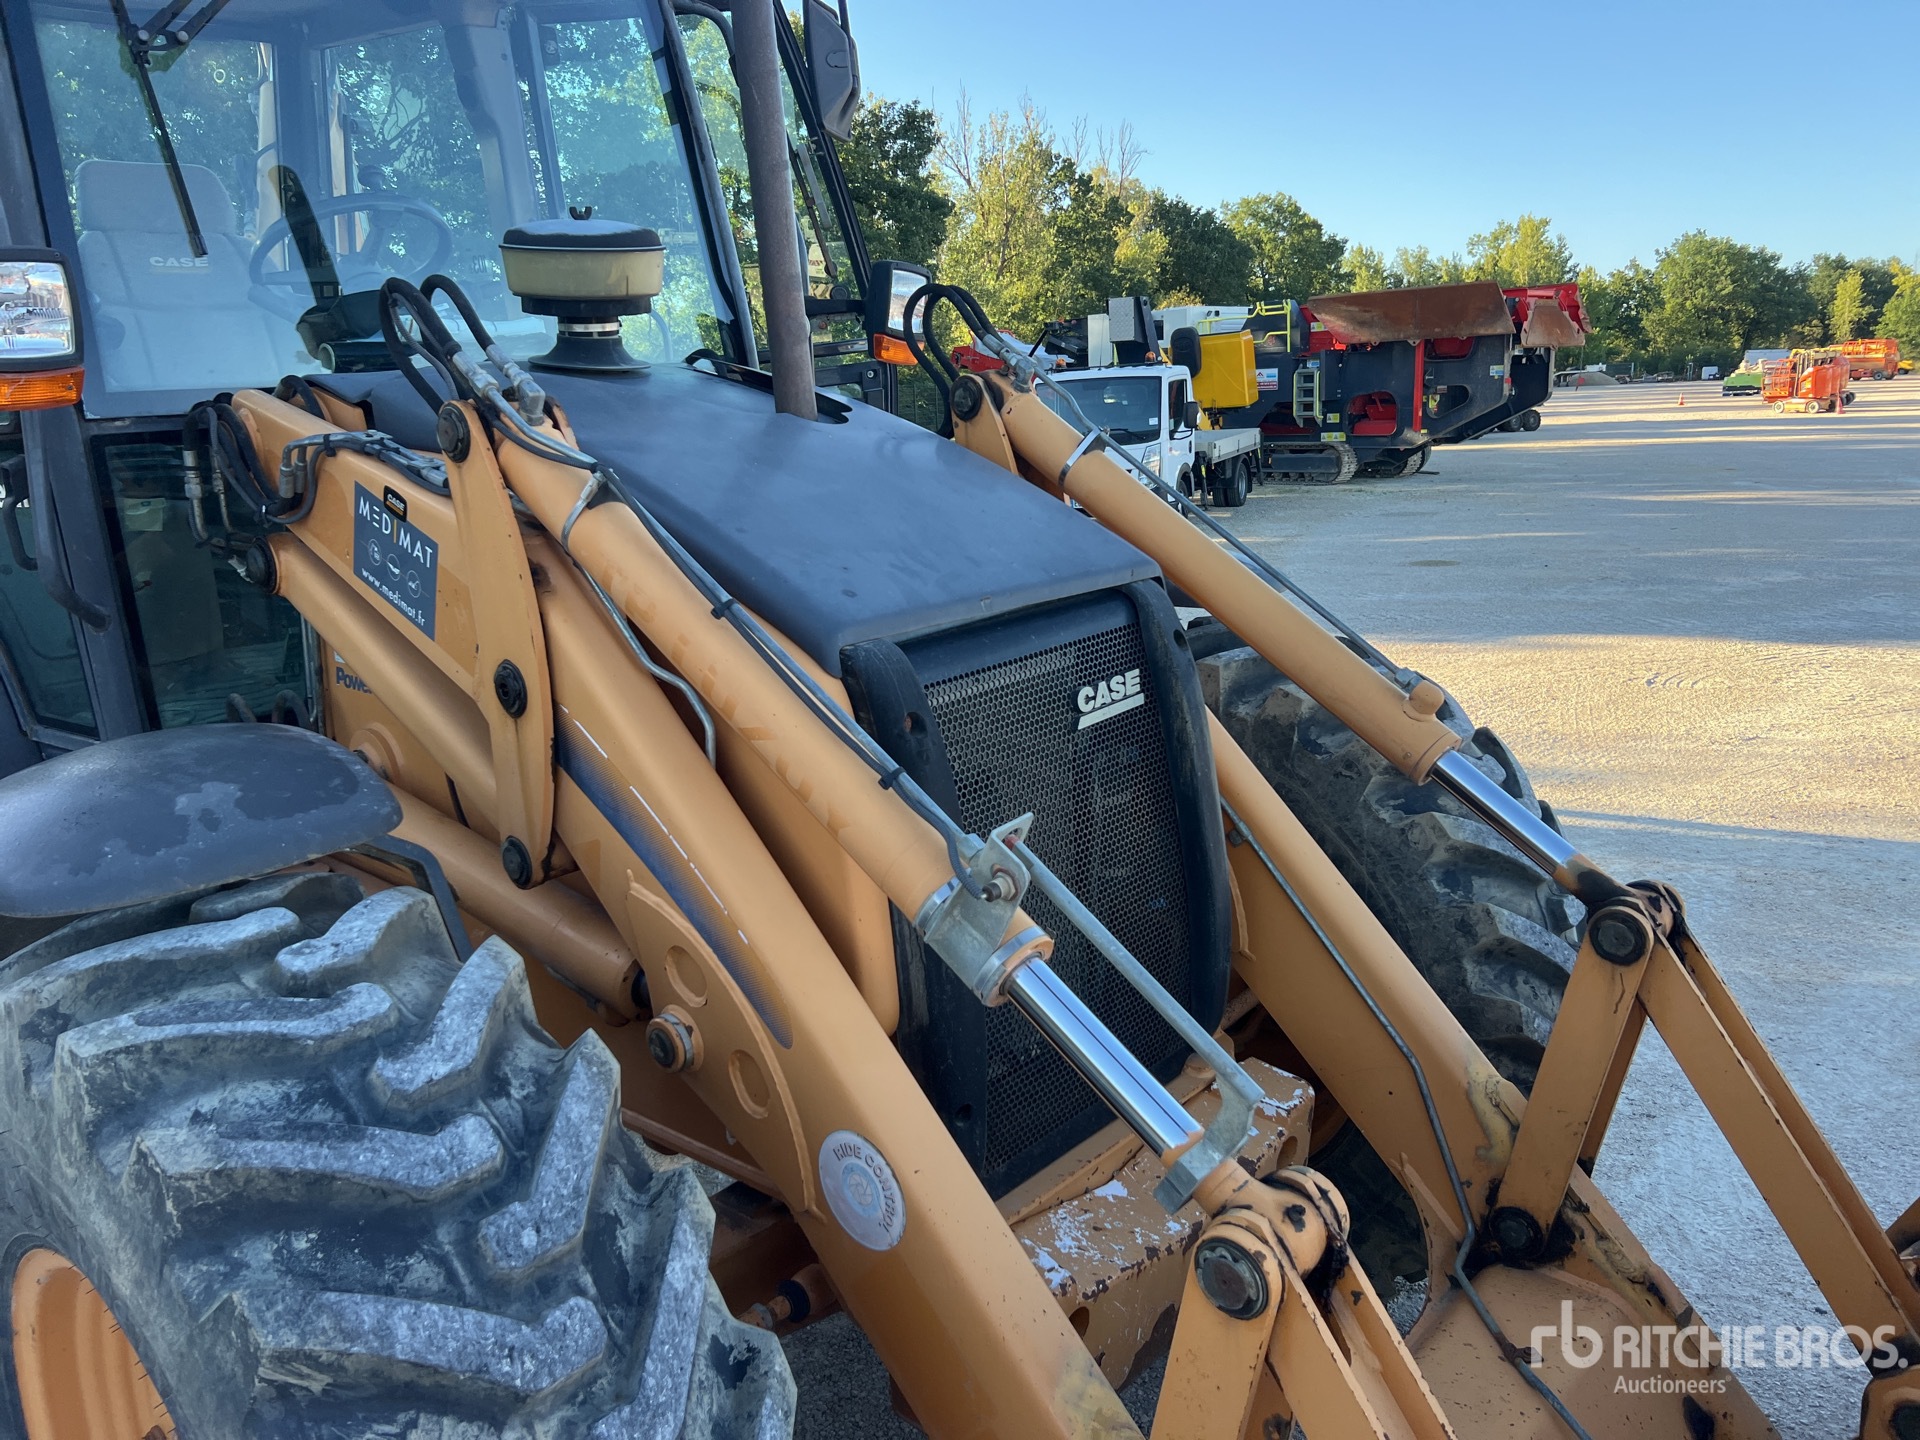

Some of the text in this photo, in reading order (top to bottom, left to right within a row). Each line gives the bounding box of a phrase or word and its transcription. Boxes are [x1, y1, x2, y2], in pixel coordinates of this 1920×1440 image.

[149, 256, 209, 267] CASE
[387, 493, 405, 512] CASE
[359, 496, 434, 569] MEDIMAT
[361, 567, 426, 627] www.medimat.fr
[335, 666, 372, 694] Powe
[1077, 668, 1141, 713] CASE
[832, 1142, 897, 1233] RIDE CONTROL
